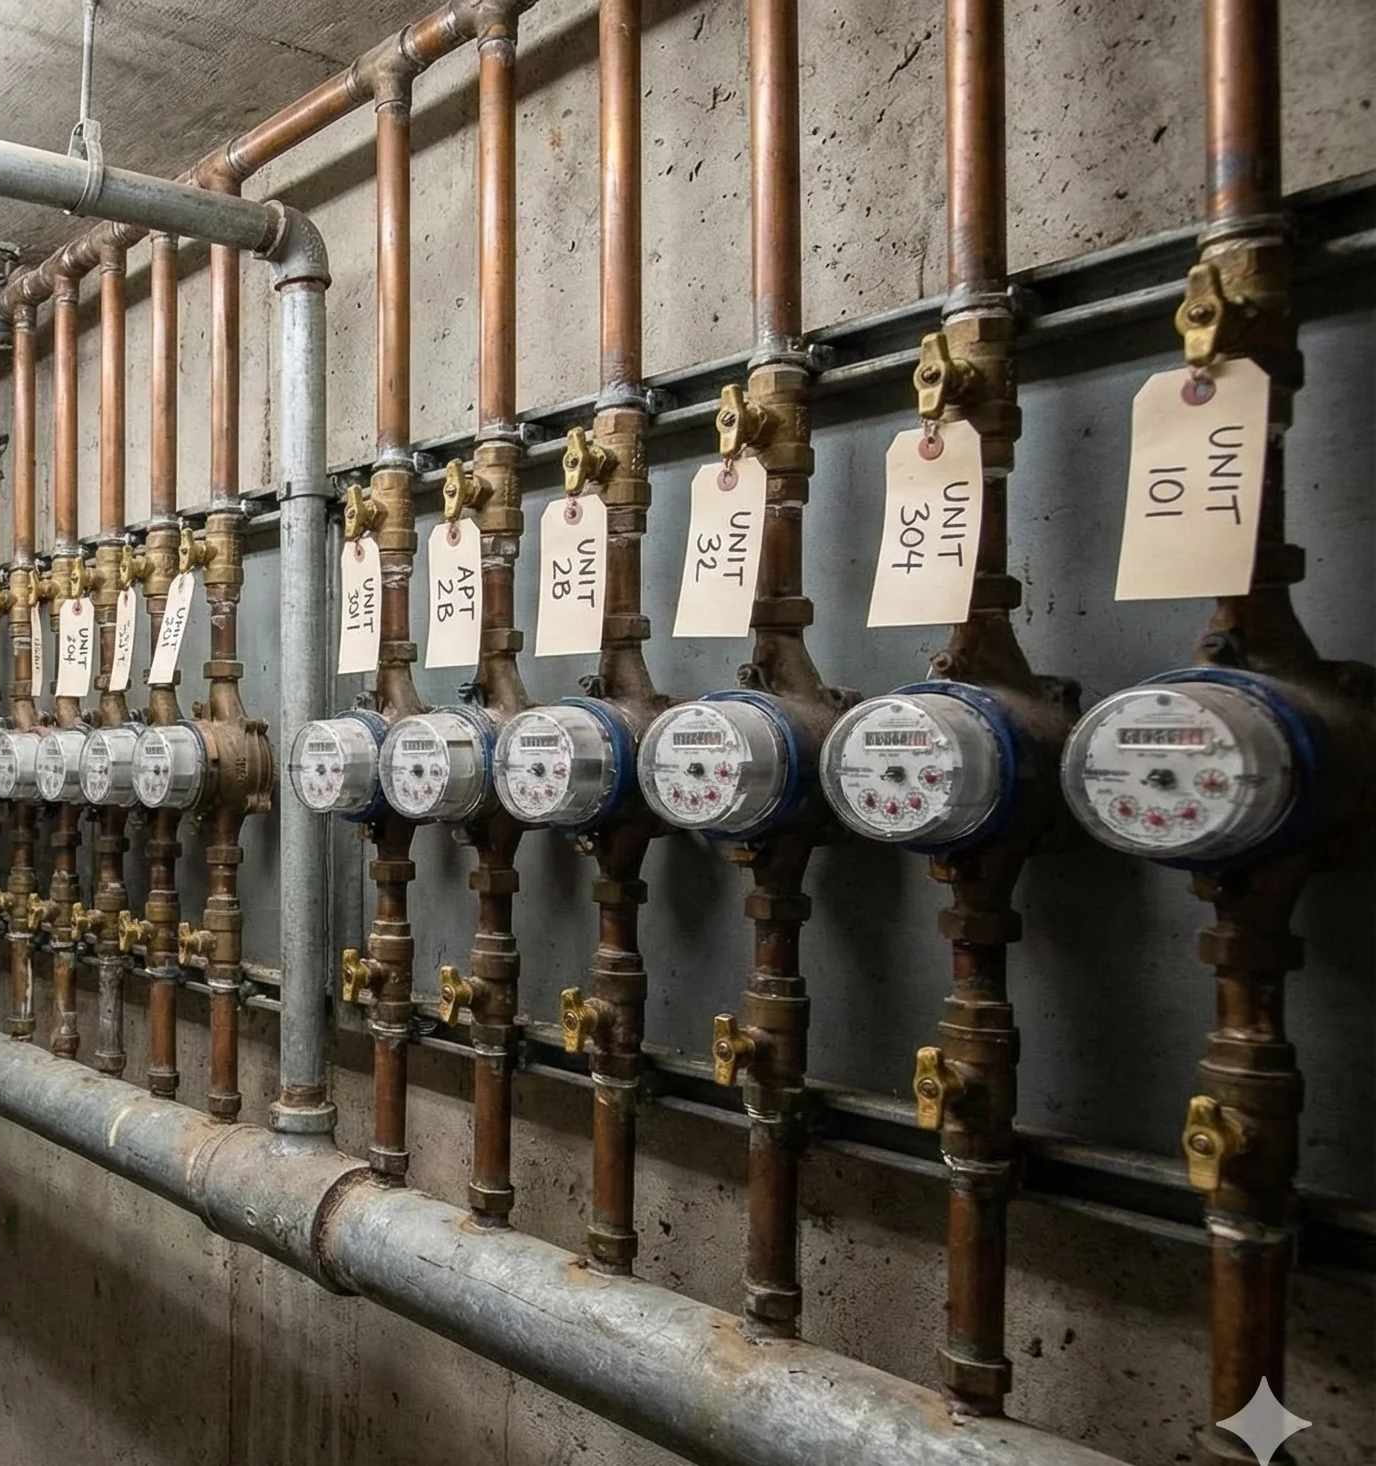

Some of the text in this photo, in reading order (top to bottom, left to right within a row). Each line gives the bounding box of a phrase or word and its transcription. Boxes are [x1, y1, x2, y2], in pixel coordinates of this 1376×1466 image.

[1145, 467, 1186, 517] 101
[1206, 426, 1244, 525] UNIT
[723, 512, 751, 586] UNIT
[892, 503, 930, 574] 304
[938, 481, 970, 567] UNIT
[552, 558, 572, 599] 2B
[577, 539, 596, 608] UNIT
[696, 534, 721, 582] 32
[363, 578, 374, 633] UNIT
[437, 580, 454, 622] 2B
[458, 567, 474, 620] APT
[78, 628, 88, 669] UNIT
